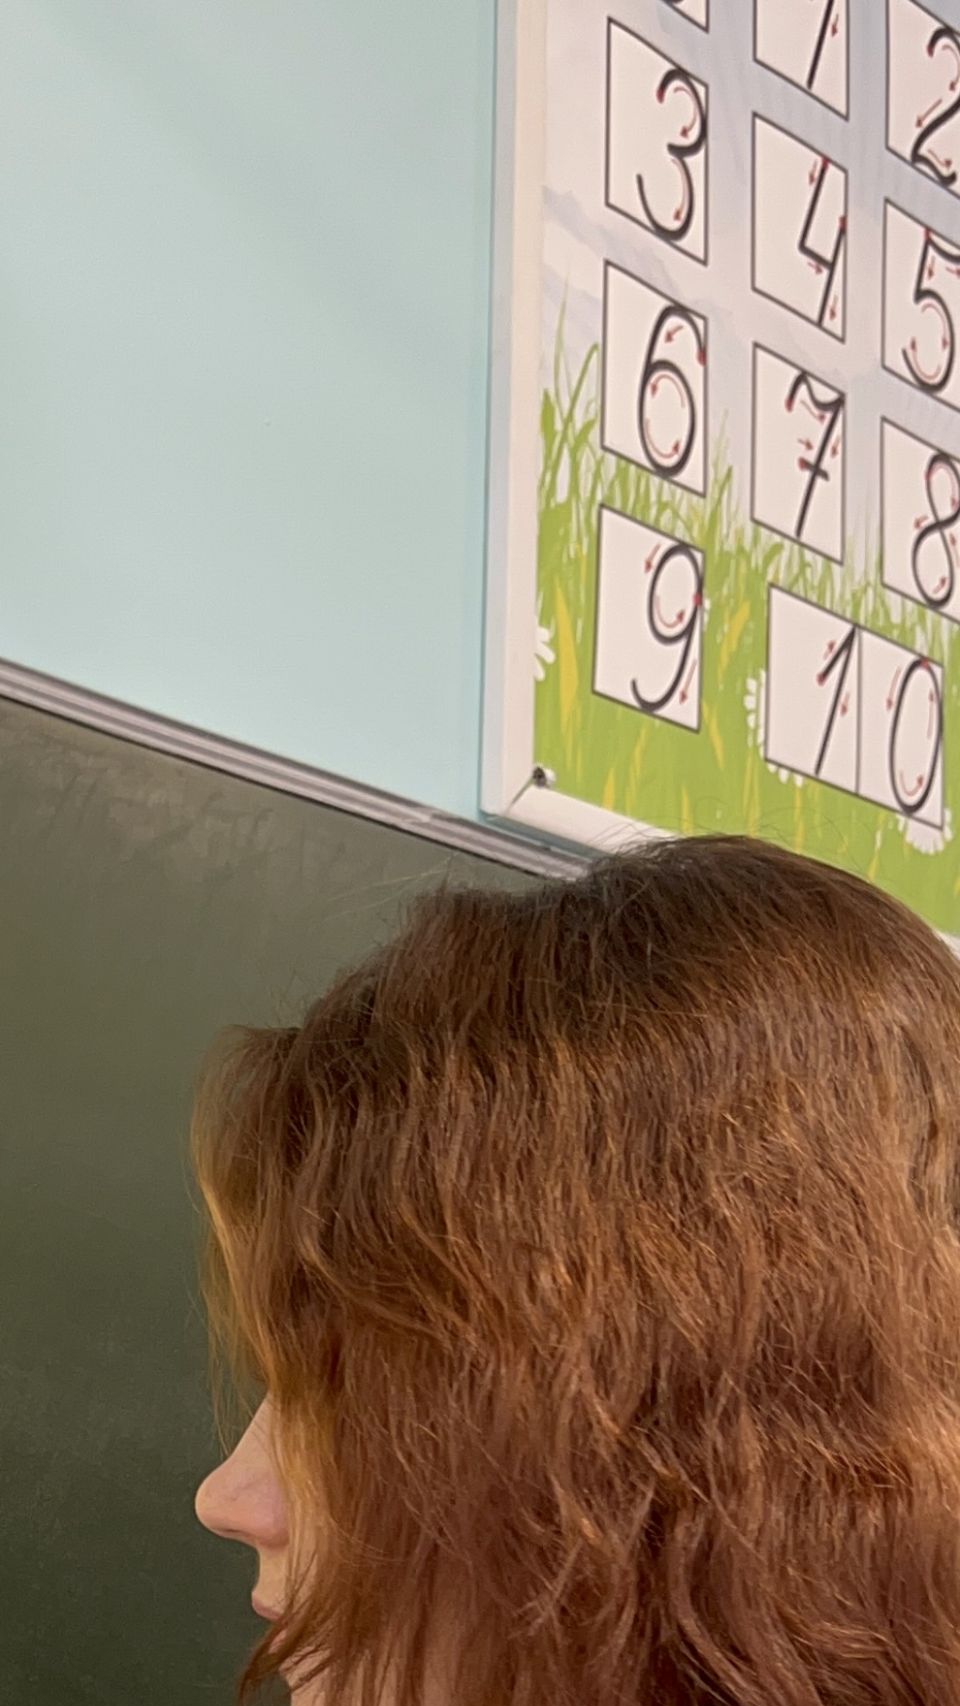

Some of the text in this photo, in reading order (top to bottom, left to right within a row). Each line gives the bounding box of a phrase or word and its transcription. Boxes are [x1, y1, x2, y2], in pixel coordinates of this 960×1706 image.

[637, 68, 960, 393] 3 4 5
[911, 27, 960, 187] 2
[638, 304, 960, 609] 6 7 8
[632, 543, 942, 814] 9 10
